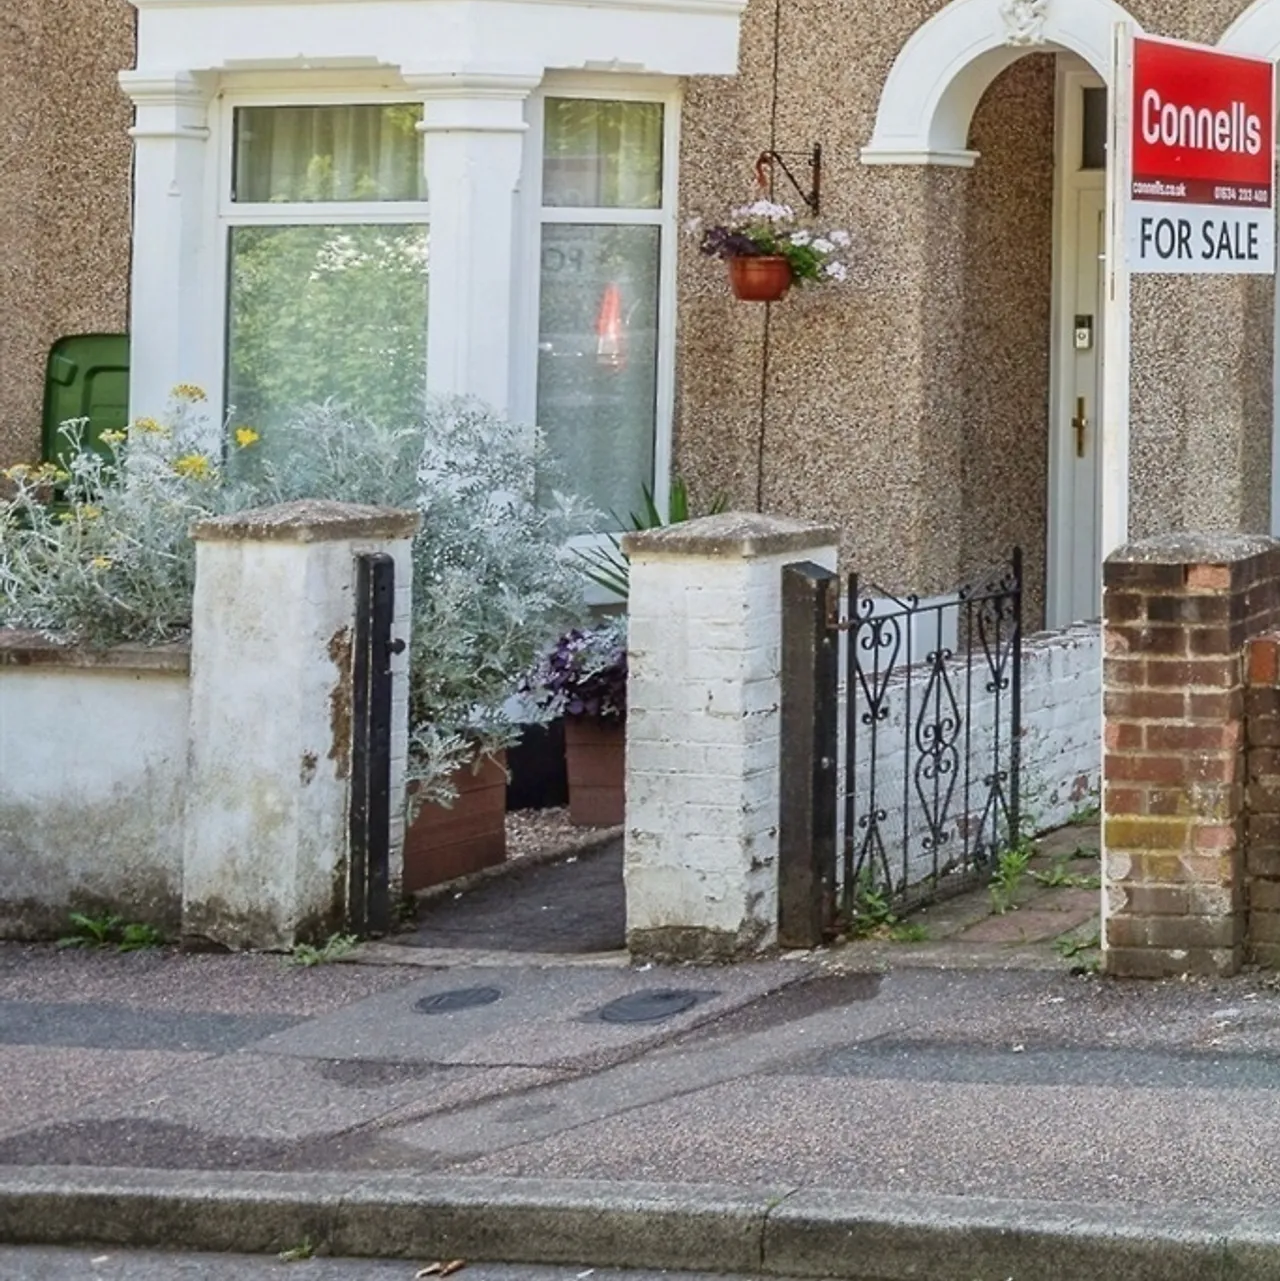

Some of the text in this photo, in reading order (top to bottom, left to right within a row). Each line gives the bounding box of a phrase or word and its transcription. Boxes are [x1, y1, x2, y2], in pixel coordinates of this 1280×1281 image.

[1142, 88, 1262, 155] Connells
[1132, 180, 1186, 197] connells.co.uk
[1140, 217, 1259, 260] FOR SALE
